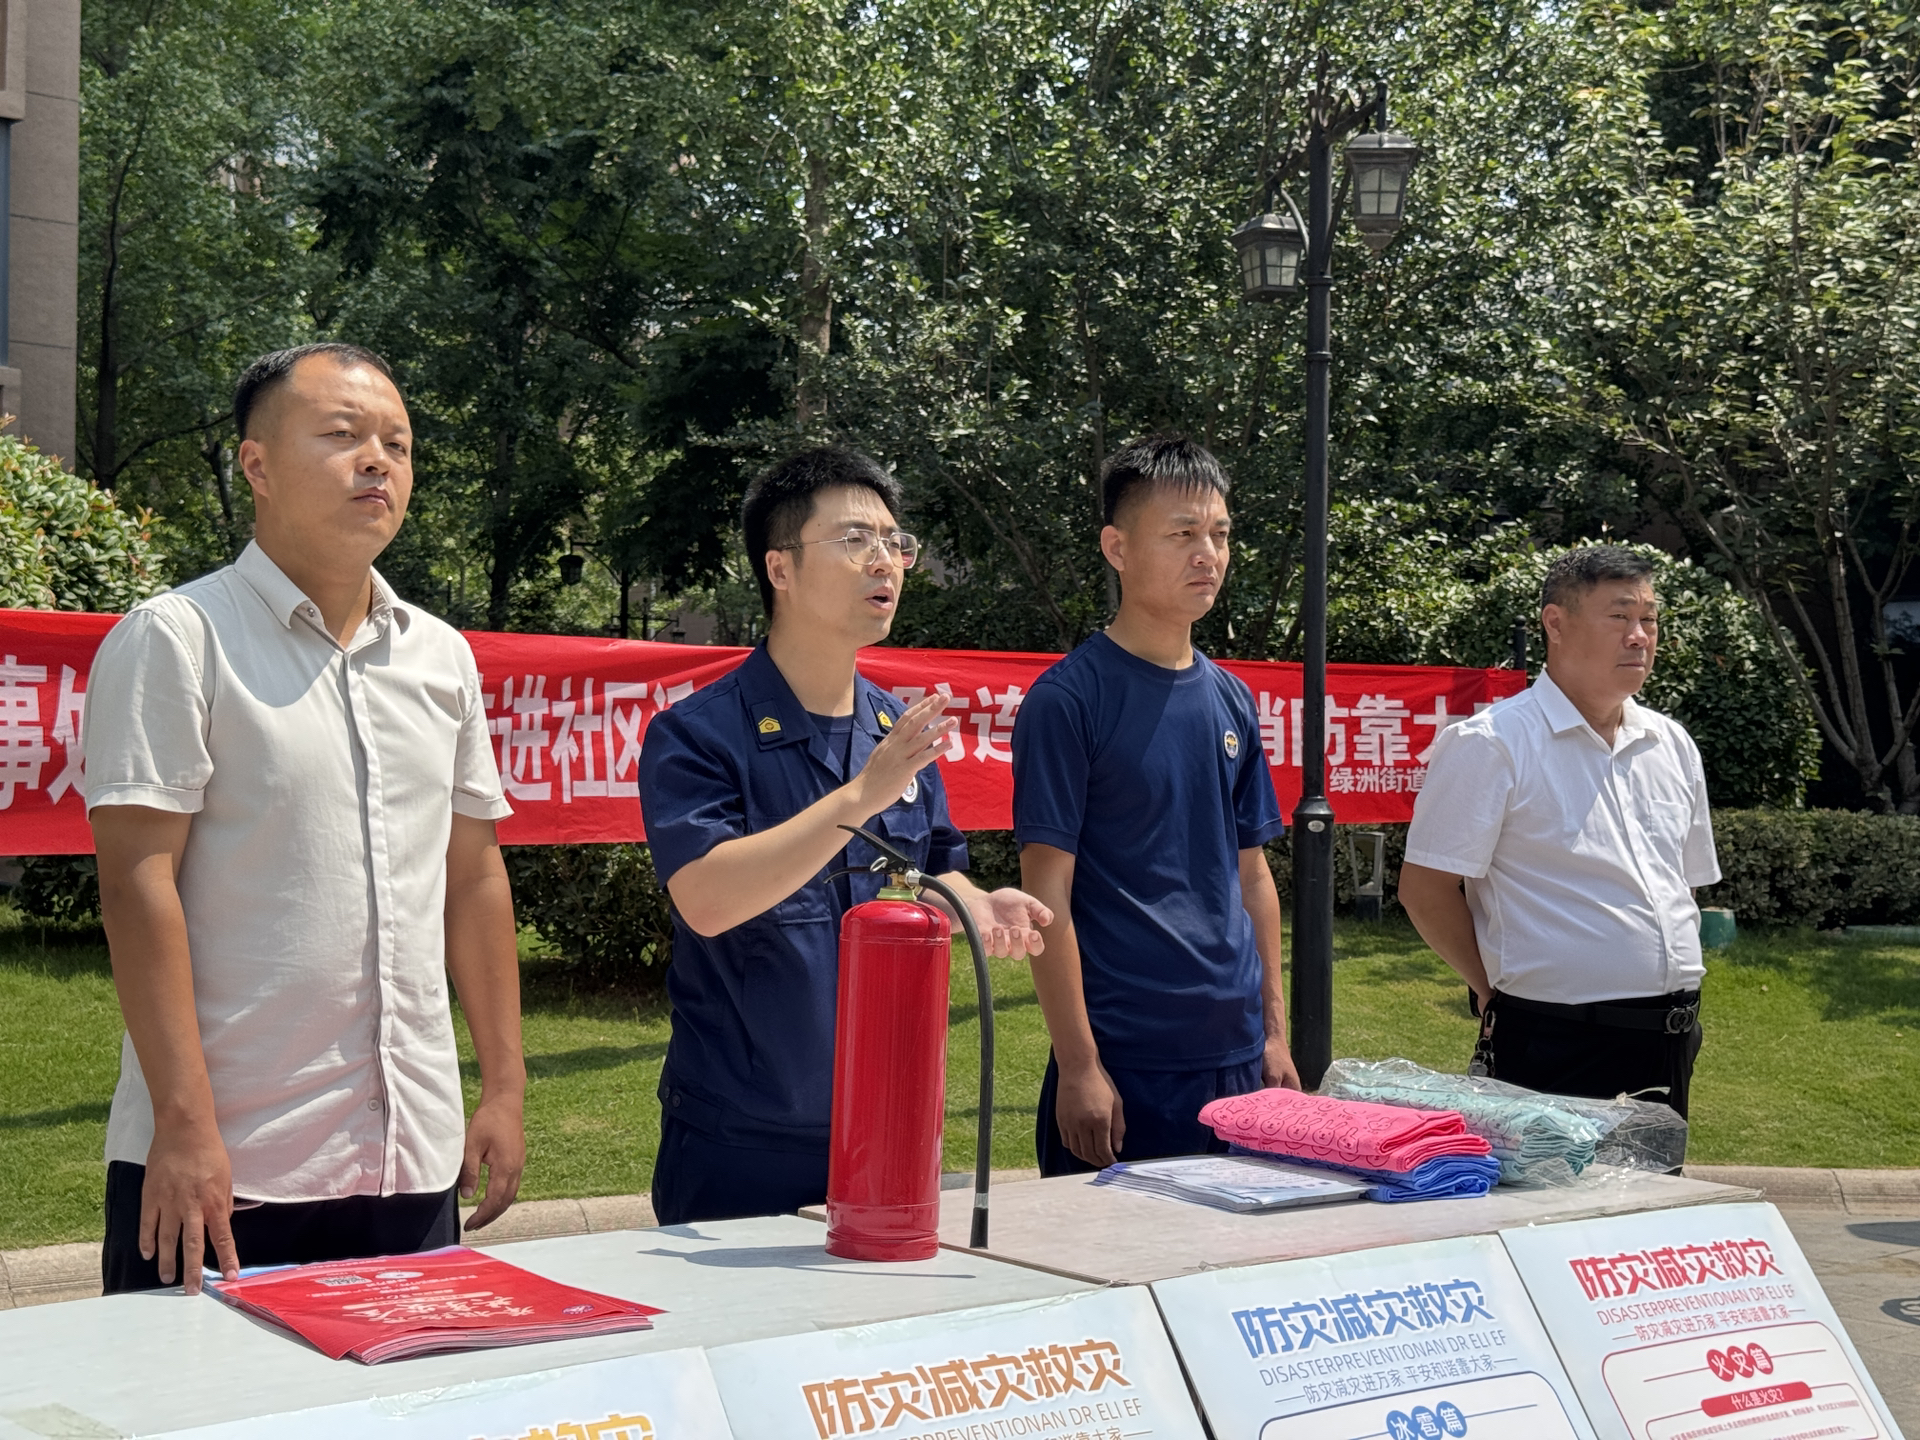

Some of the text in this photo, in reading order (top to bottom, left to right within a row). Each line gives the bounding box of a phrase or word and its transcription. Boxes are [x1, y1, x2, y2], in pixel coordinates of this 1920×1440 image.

[479, 673, 695, 804] 进社区
[1329, 766, 1428, 794] 绿洲街道
[1570, 1238, 1784, 1301] 防灾减灾救灾
[1231, 1279, 1495, 1359] 防灾减灾救灾
[1597, 1288, 1751, 1326] DISASTERPREVENTIONAN
[1259, 1338, 1448, 1387] DISASTERPREVENTIONAN
[1303, 1353, 1497, 1404] 防灾减灾进万家 平安和谐靠大家
[1710, 1347, 1772, 1378] 火灾篇
[801, 1339, 1132, 1440] 防灾减灾救灾
[1389, 1406, 1464, 1440] 冰雹篇
